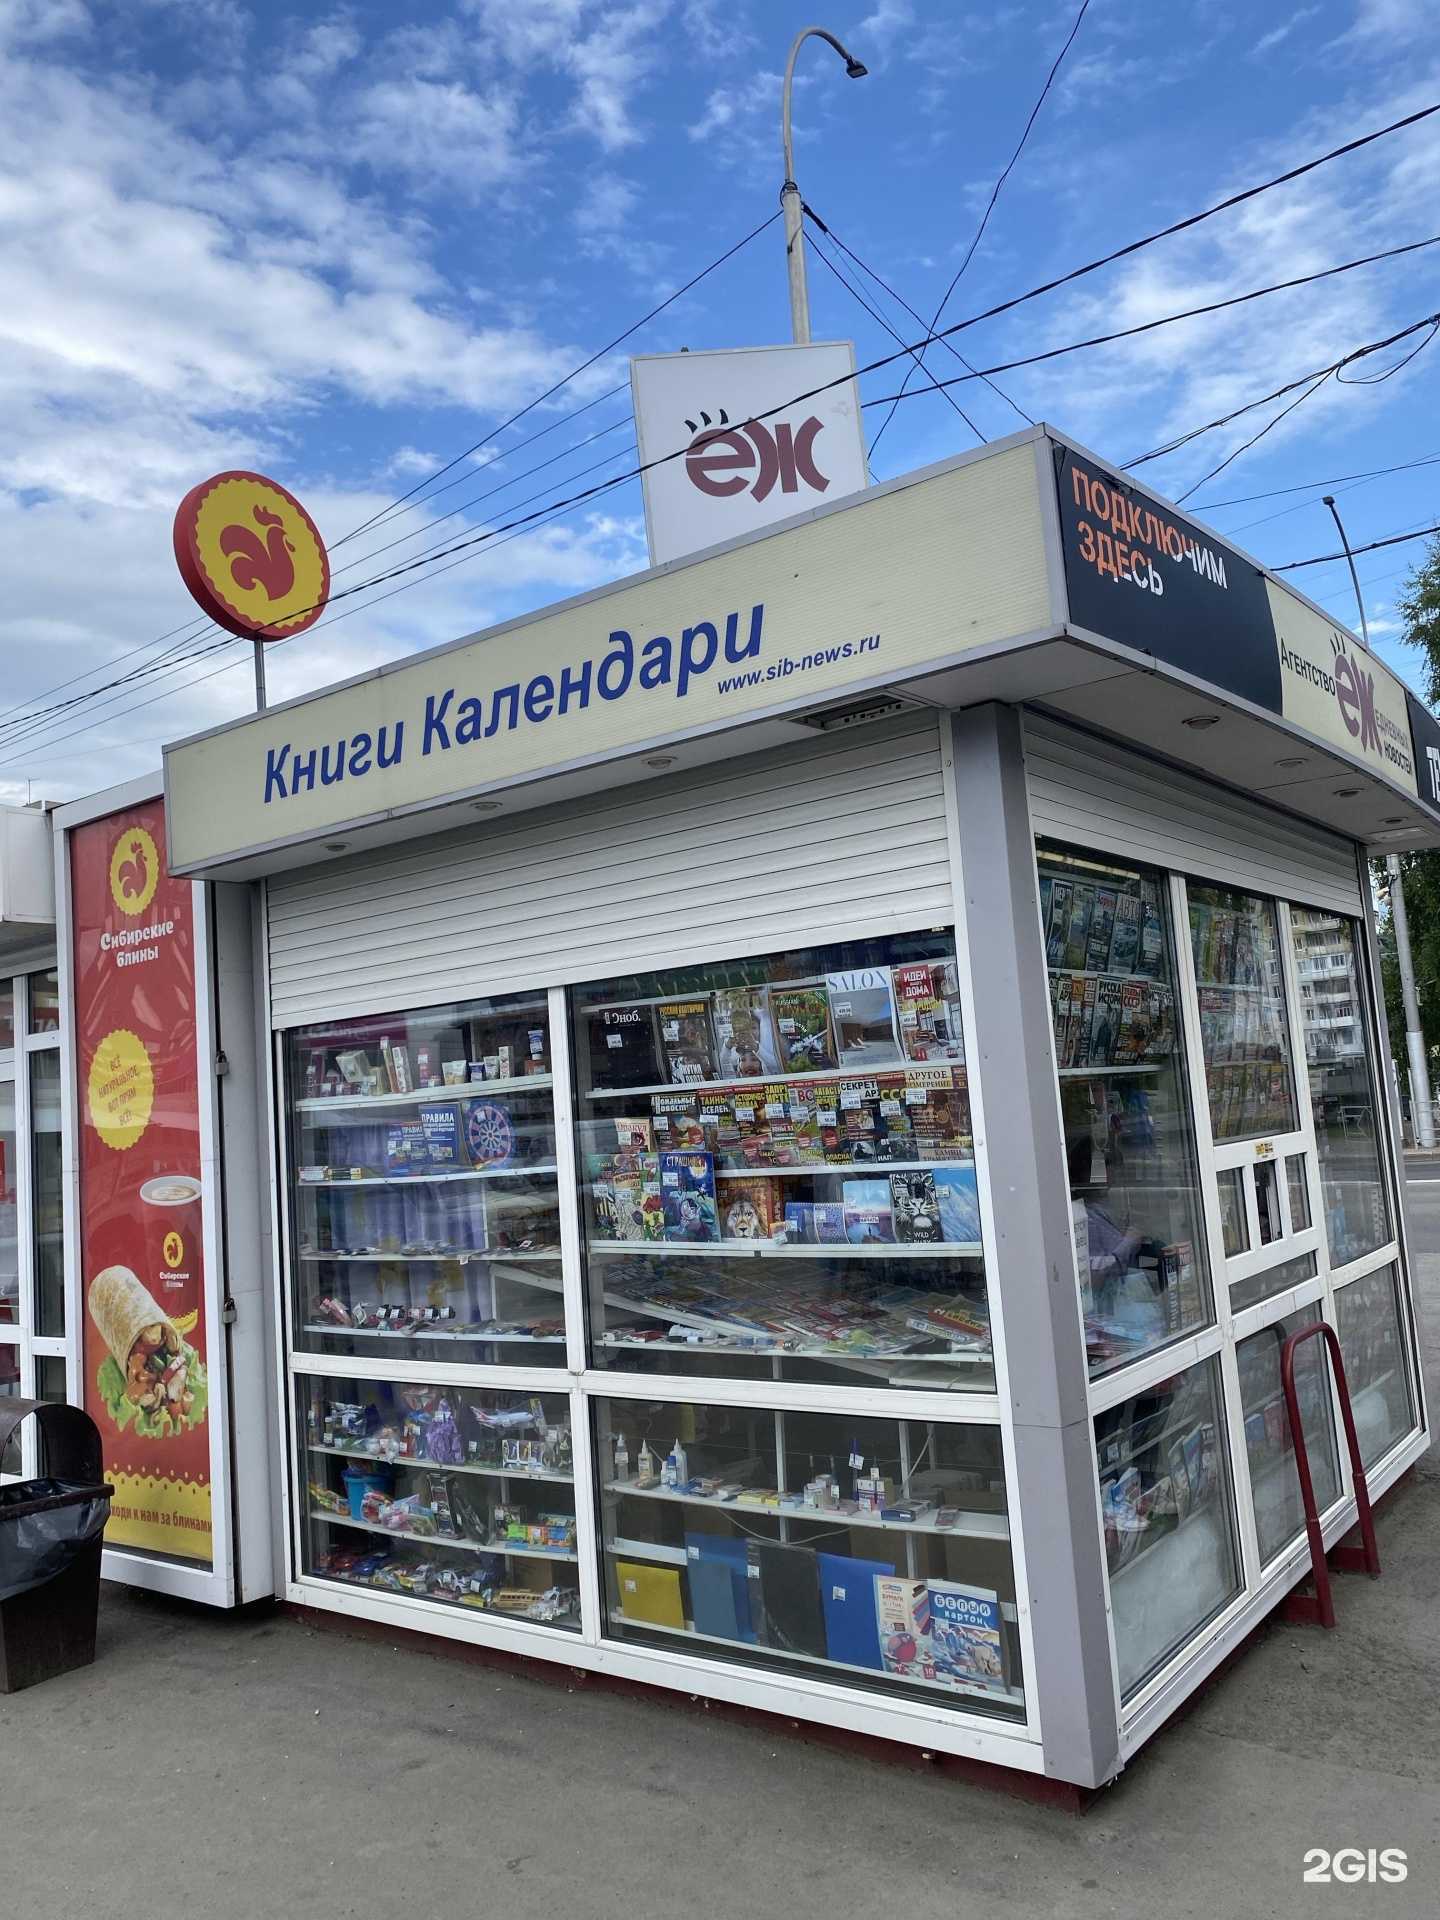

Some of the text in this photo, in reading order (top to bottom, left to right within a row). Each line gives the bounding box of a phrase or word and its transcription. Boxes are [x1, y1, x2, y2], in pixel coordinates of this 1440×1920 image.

[1072, 466, 1228, 589] ПОДКЛЮЧИМ
[1077, 520, 1164, 596] ЗДЕСЬ
[717, 634, 881, 695] www.sib-news.ru
[264, 604, 765, 803] Книги Календари
[100, 920, 174, 951] Сибирские
[116, 945, 159, 968] блины
[827, 969, 888, 993] SALON
[903, 970, 927, 983] ИДЕИ
[906, 985, 930, 997] ДОМА
[840, 1080, 875, 1091] СЕКРЕТ
[908, 1070, 947, 1080] ДРУГОЕ
[421, 1112, 455, 1123] ПРАВИЛА
[141, 1510, 160, 1524] нам
[161, 1513, 171, 1525] за
[934, 1594, 991, 1617] БЕЛЫЙ
[944, 1609, 983, 1625] картон
